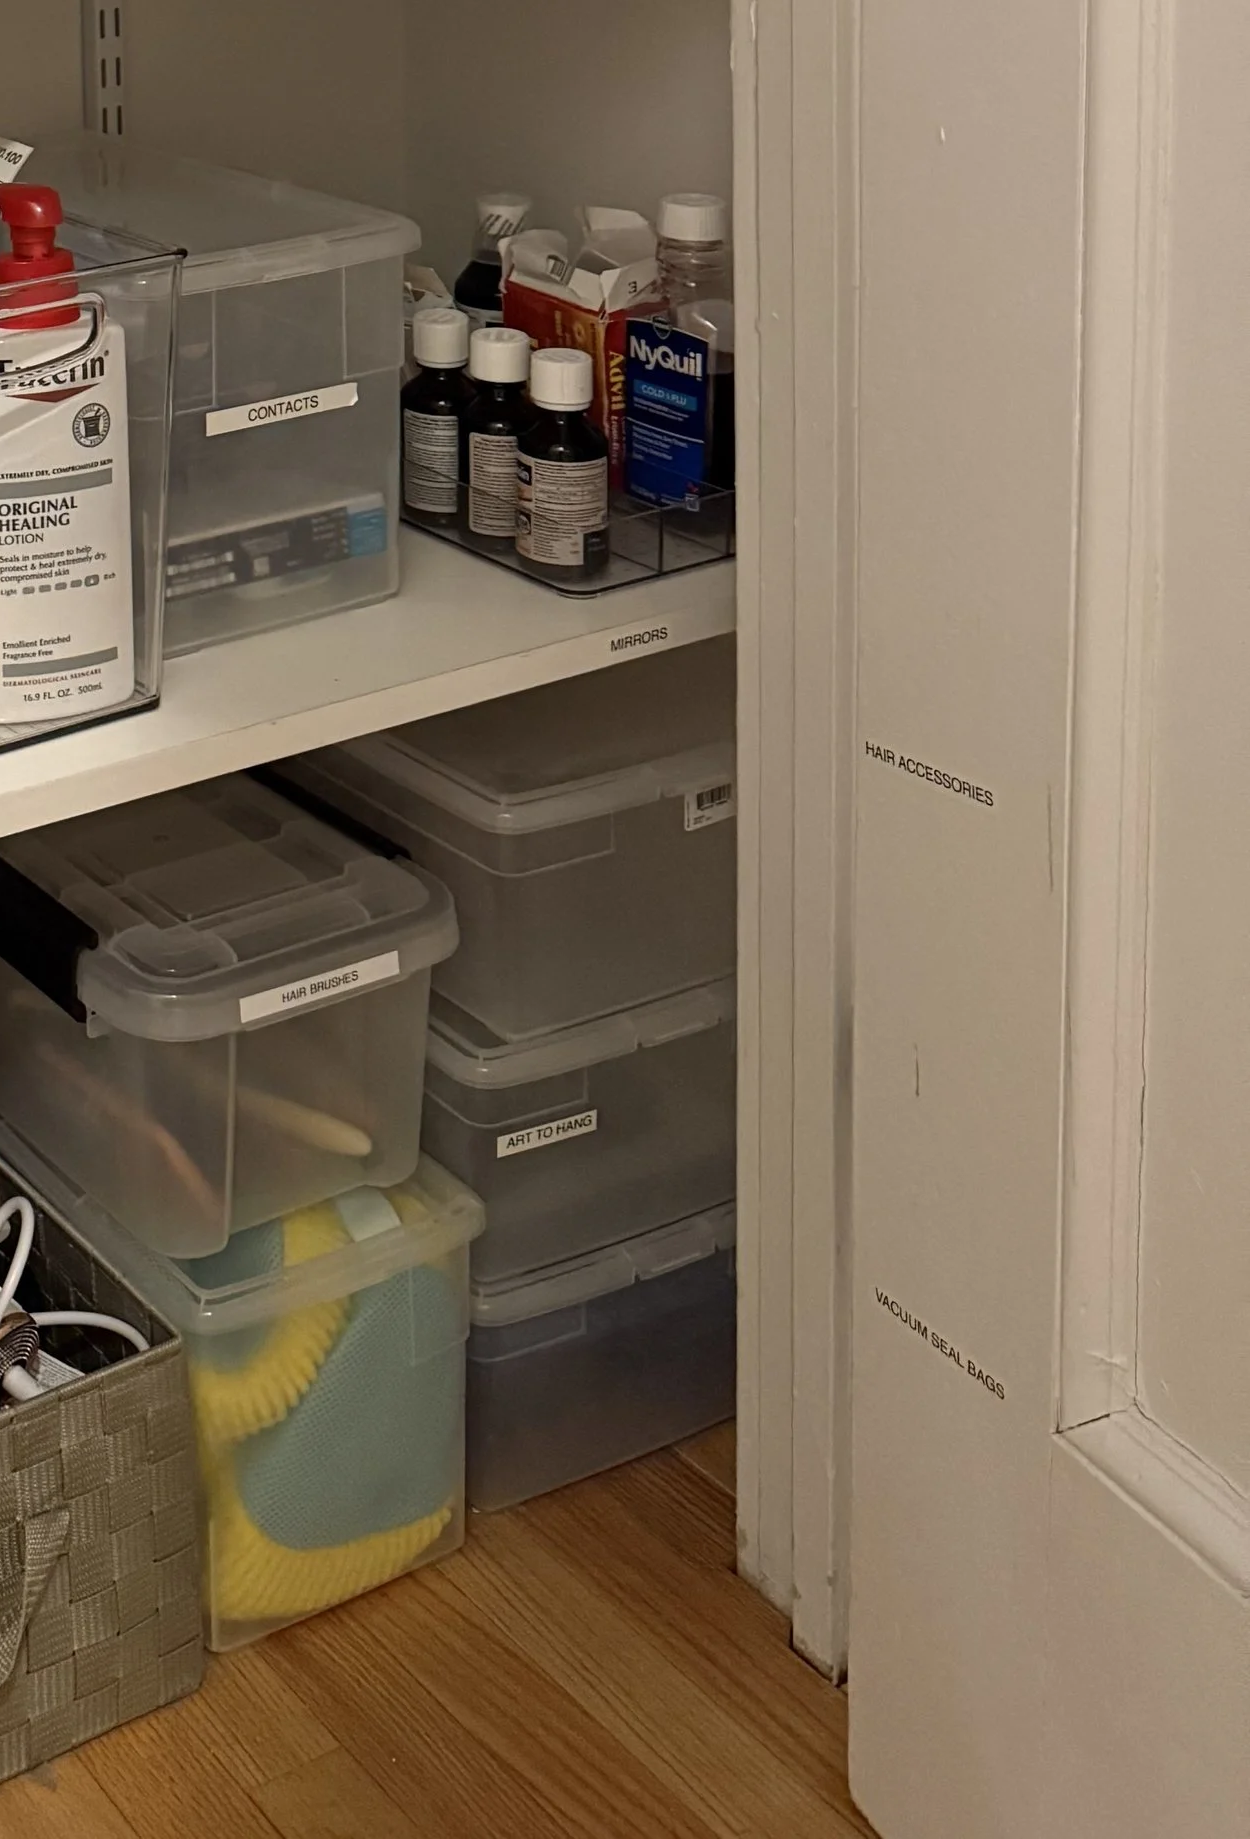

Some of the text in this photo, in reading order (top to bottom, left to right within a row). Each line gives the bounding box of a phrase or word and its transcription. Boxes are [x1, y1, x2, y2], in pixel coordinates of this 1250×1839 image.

[629, 335, 703, 379] NyQuil
[609, 351, 626, 411] Advil
[641, 384, 665, 399] COLD
[670, 392, 687, 406] FLU
[248, 395, 319, 422] CONTACTS
[0, 555, 20, 564] Seals
[32, 550, 65, 560] moisture
[76, 545, 92, 556] help
[0, 565, 28, 574] protect
[30, 563, 37, 571] &
[39, 561, 55, 569] heal
[57, 556, 93, 567] extremely
[0, 569, 70, 584] compromised skin
[2, 635, 71, 650] Emollient Enriched
[610, 627, 669, 652] MIRRORS
[2, 651, 37, 661] Fragrance
[3, 675, 68, 687] DERMATOLOGICAL
[23, 693, 40, 702] 16.9
[865, 741, 994, 807] HAIR ACCESSORIES
[282, 970, 359, 1003] HAIR BRUSHES
[506, 1114, 593, 1149] ART TO HANG
[875, 1287, 1005, 1400] VACUUM SEAL BAGS
